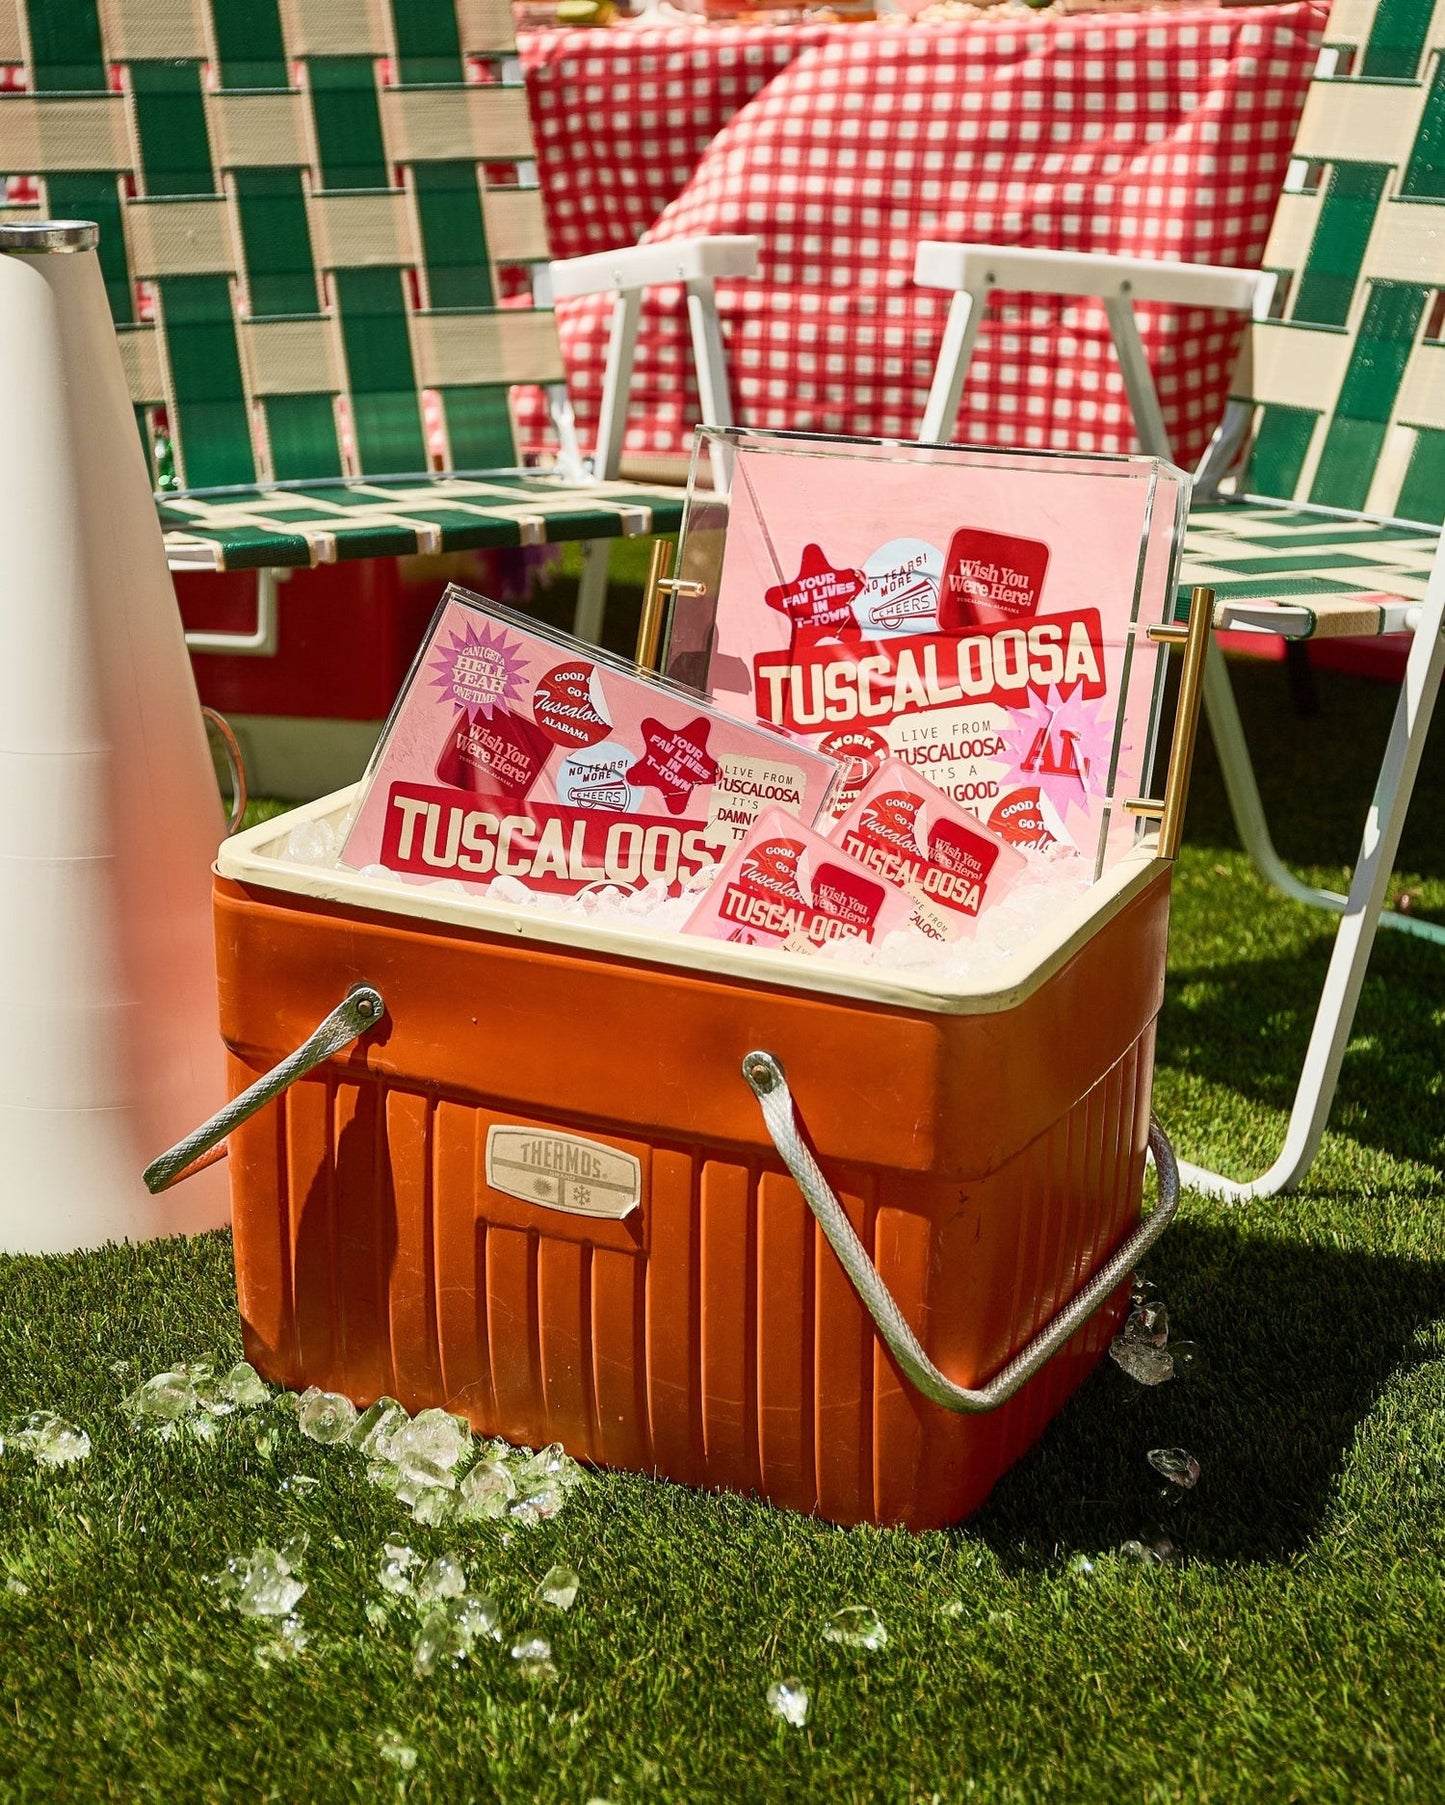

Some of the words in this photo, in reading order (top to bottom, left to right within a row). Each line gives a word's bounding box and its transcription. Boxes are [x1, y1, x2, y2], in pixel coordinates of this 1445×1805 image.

[798, 572, 837, 590] YOUR
[863, 579, 879, 596] NO
[883, 553, 928, 583] TEARS!
[880, 572, 913, 598] MORE
[959, 558, 999, 584] Wish
[999, 567, 1030, 589] You
[782, 592, 809, 609] FAV
[812, 581, 856, 599] LIVES
[949, 574, 989, 597] Were
[988, 582, 1034, 607] Here!
[794, 606, 851, 629] T-TOWN
[812, 600, 829, 613] IN
[879, 594, 931, 618] CHEERS
[455, 654, 508, 681] HELL
[554, 672, 586, 682] GOOD
[758, 621, 1102, 726] TUSCALOOSA
[451, 667, 507, 694] YEAH
[566, 686, 582, 698] GO
[542, 716, 589, 742] ALABAMA
[901, 726, 939, 743] LIVE
[952, 720, 992, 736] FROM
[469, 723, 505, 755] Wish
[504, 743, 531, 769] You
[650, 734, 675, 754] FAV
[674, 749, 711, 779] LIVES
[671, 734, 704, 761] YOUR
[894, 736, 1007, 766] TUSCALOOSA
[456, 732, 491, 763] Were
[490, 753, 532, 785] Here!
[569, 766, 583, 776] NO
[588, 760, 629, 774] TEARS!
[666, 757, 682, 774] IN
[583, 770, 612, 783] MORE
[646, 755, 693, 792] T-TOWN
[725, 765, 754, 778] LIVE
[763, 772, 794, 785] FROM
[968, 764, 978, 777] A
[577, 791, 621, 803] CHEERS
[953, 780, 1000, 801] GOOD
[732, 797, 759, 810] IT'S
[886, 798, 914, 812] GOOD
[1001, 800, 1034, 818] GOOD
[717, 807, 752, 826] DAMN
[894, 814, 907, 826] GO
[1018, 818, 1036, 830] GO
[393, 796, 718, 887] TUSCALOOS
[765, 846, 796, 859] GOOD
[927, 846, 952, 869] Were
[951, 861, 984, 880] Here!
[935, 837, 963, 862] Wish
[961, 850, 983, 871] You
[775, 862, 790, 875] GO
[845, 834, 981, 912] TUSCALOOSA
[811, 892, 838, 914] Were
[837, 906, 870, 925] Here!
[819, 883, 846, 904] Wish
[845, 896, 869, 915] You
[927, 912, 948, 932] FROM
